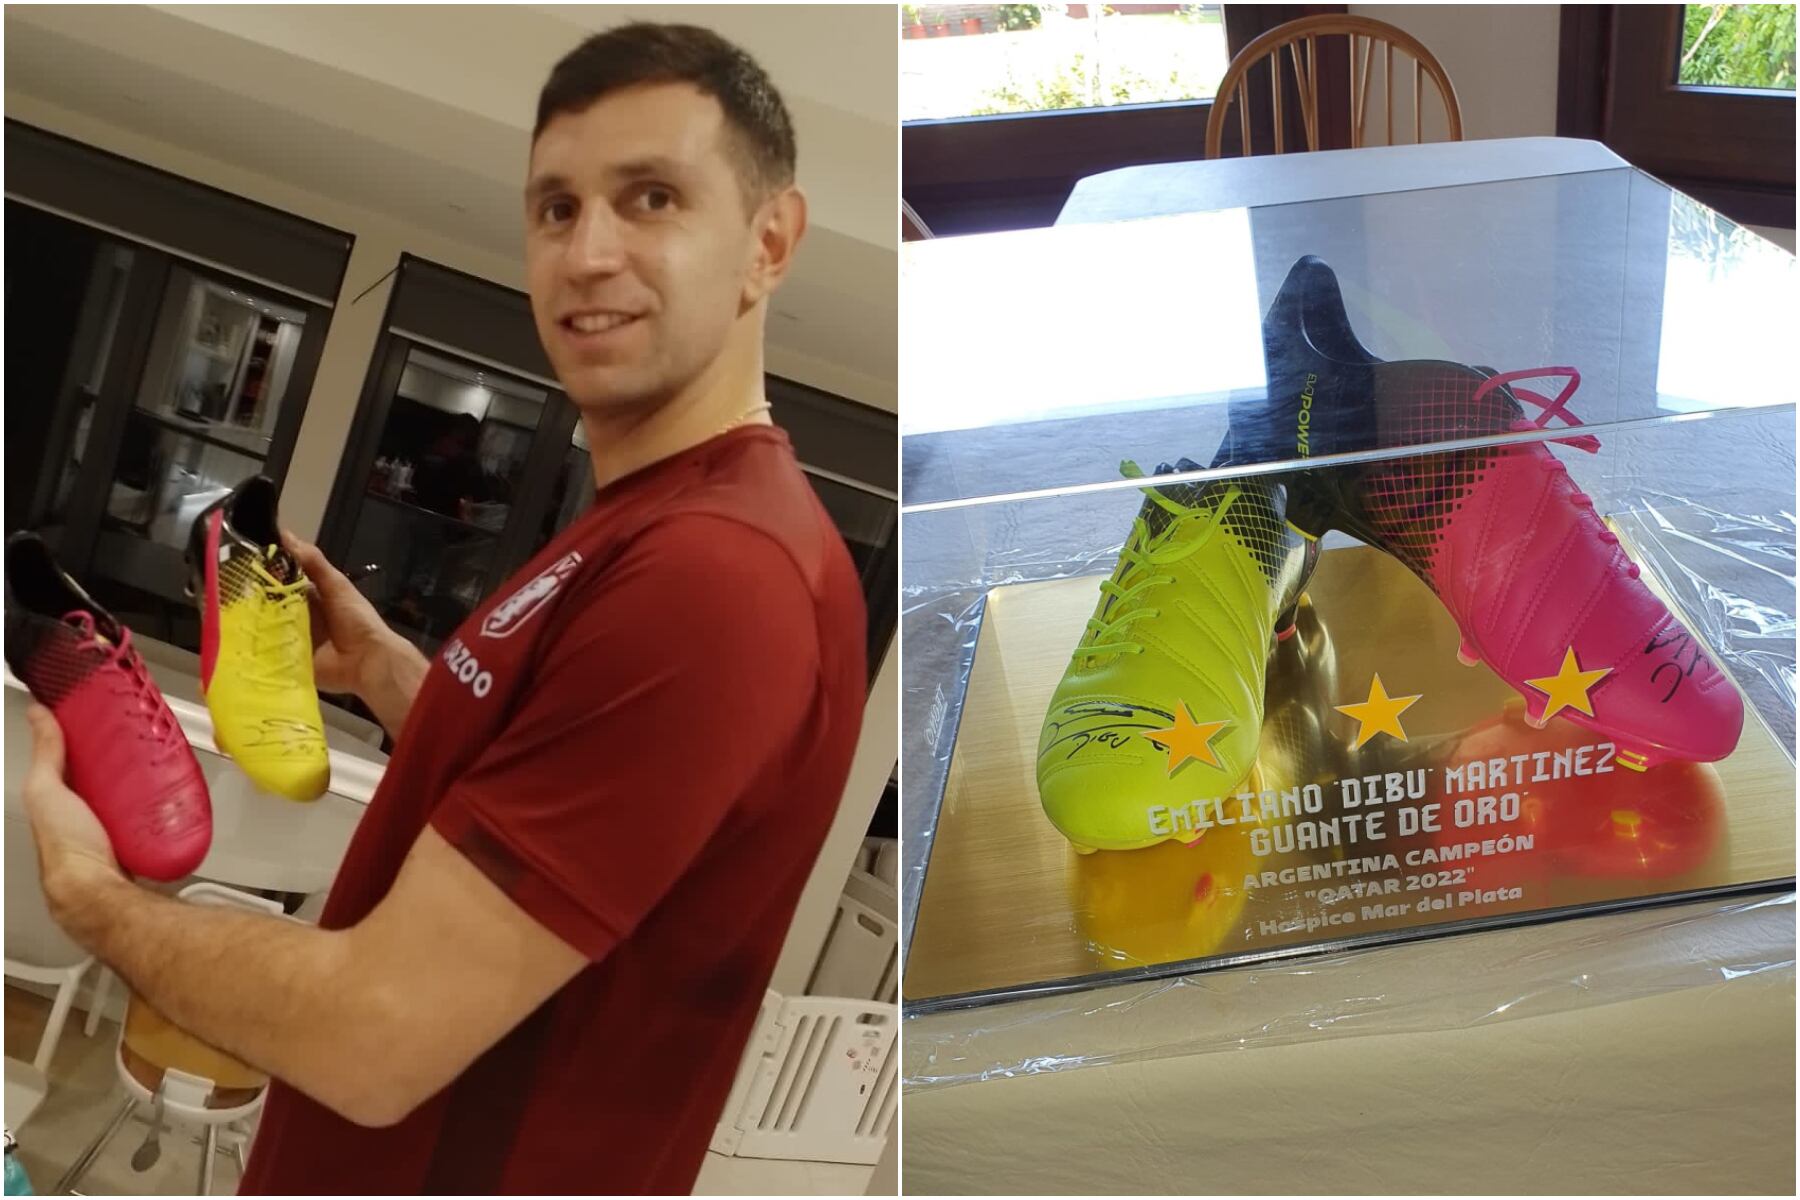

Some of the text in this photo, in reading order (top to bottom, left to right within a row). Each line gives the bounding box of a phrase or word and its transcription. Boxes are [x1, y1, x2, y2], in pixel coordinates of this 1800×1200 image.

[1147, 783, 1323, 836] EMILIANO
[1445, 742, 1616, 794] MARTINEZ
[1398, 803, 1442, 836] DE
[1243, 833, 1535, 890] ARGENTINA CAMPEÓN
[1259, 887, 1523, 936] Hospice Mar del Plata
